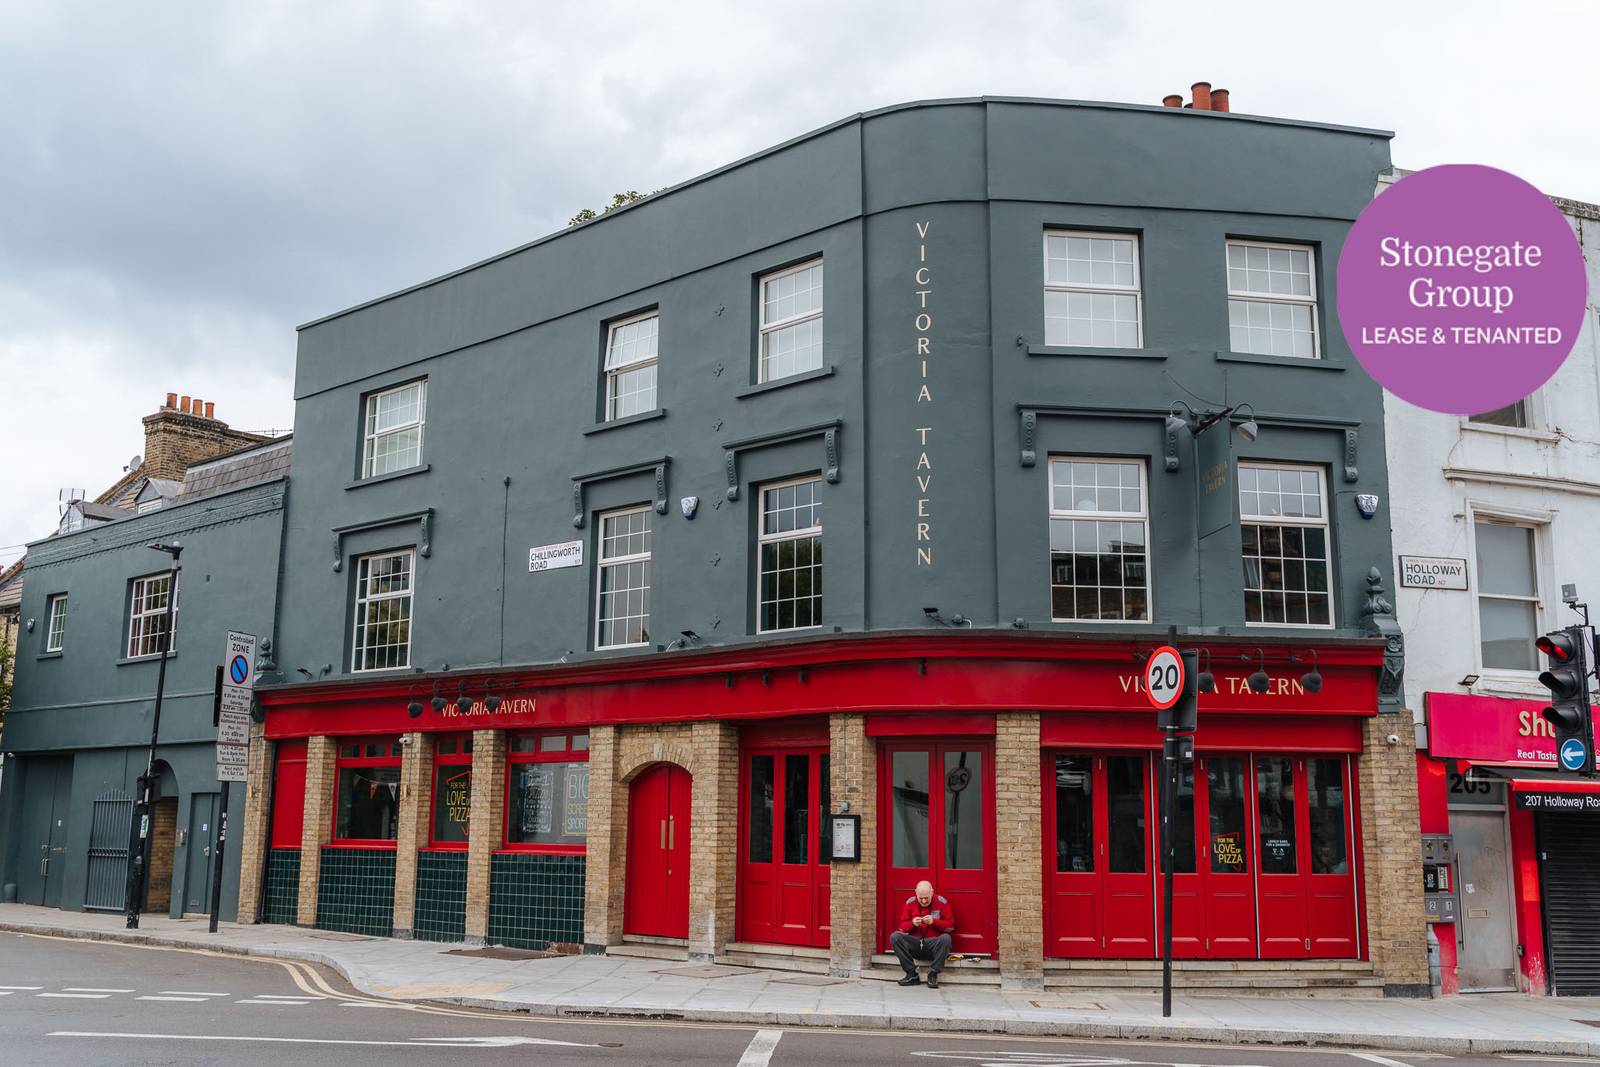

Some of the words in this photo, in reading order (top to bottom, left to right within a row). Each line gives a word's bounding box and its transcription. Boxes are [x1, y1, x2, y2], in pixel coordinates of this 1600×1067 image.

[915, 221, 932, 402] VICTORIA
[915, 427, 932, 566] TAVERN
[531, 546, 580, 561] CHILLINGWORTH
[531, 560, 548, 570] ROAD
[1406, 564, 1462, 575] HOLLOWAY
[1406, 574, 1436, 585] ROAD
[232, 643, 250, 654] ZONE
[1151, 664, 1178, 691] 20
[1225, 676, 1304, 696] TAERN
[495, 698, 537, 715] AVERN
[1517, 749, 1535, 759] Real
[1537, 750, 1557, 760] Taste
[1450, 773, 1491, 794] 205
[446, 790, 467, 806] LOVE
[1525, 795, 1542, 806] 207
[1544, 795, 1584, 809] Holloway
[1213, 843, 1236, 854] LOVE
[1218, 853, 1243, 864] PIZZA
